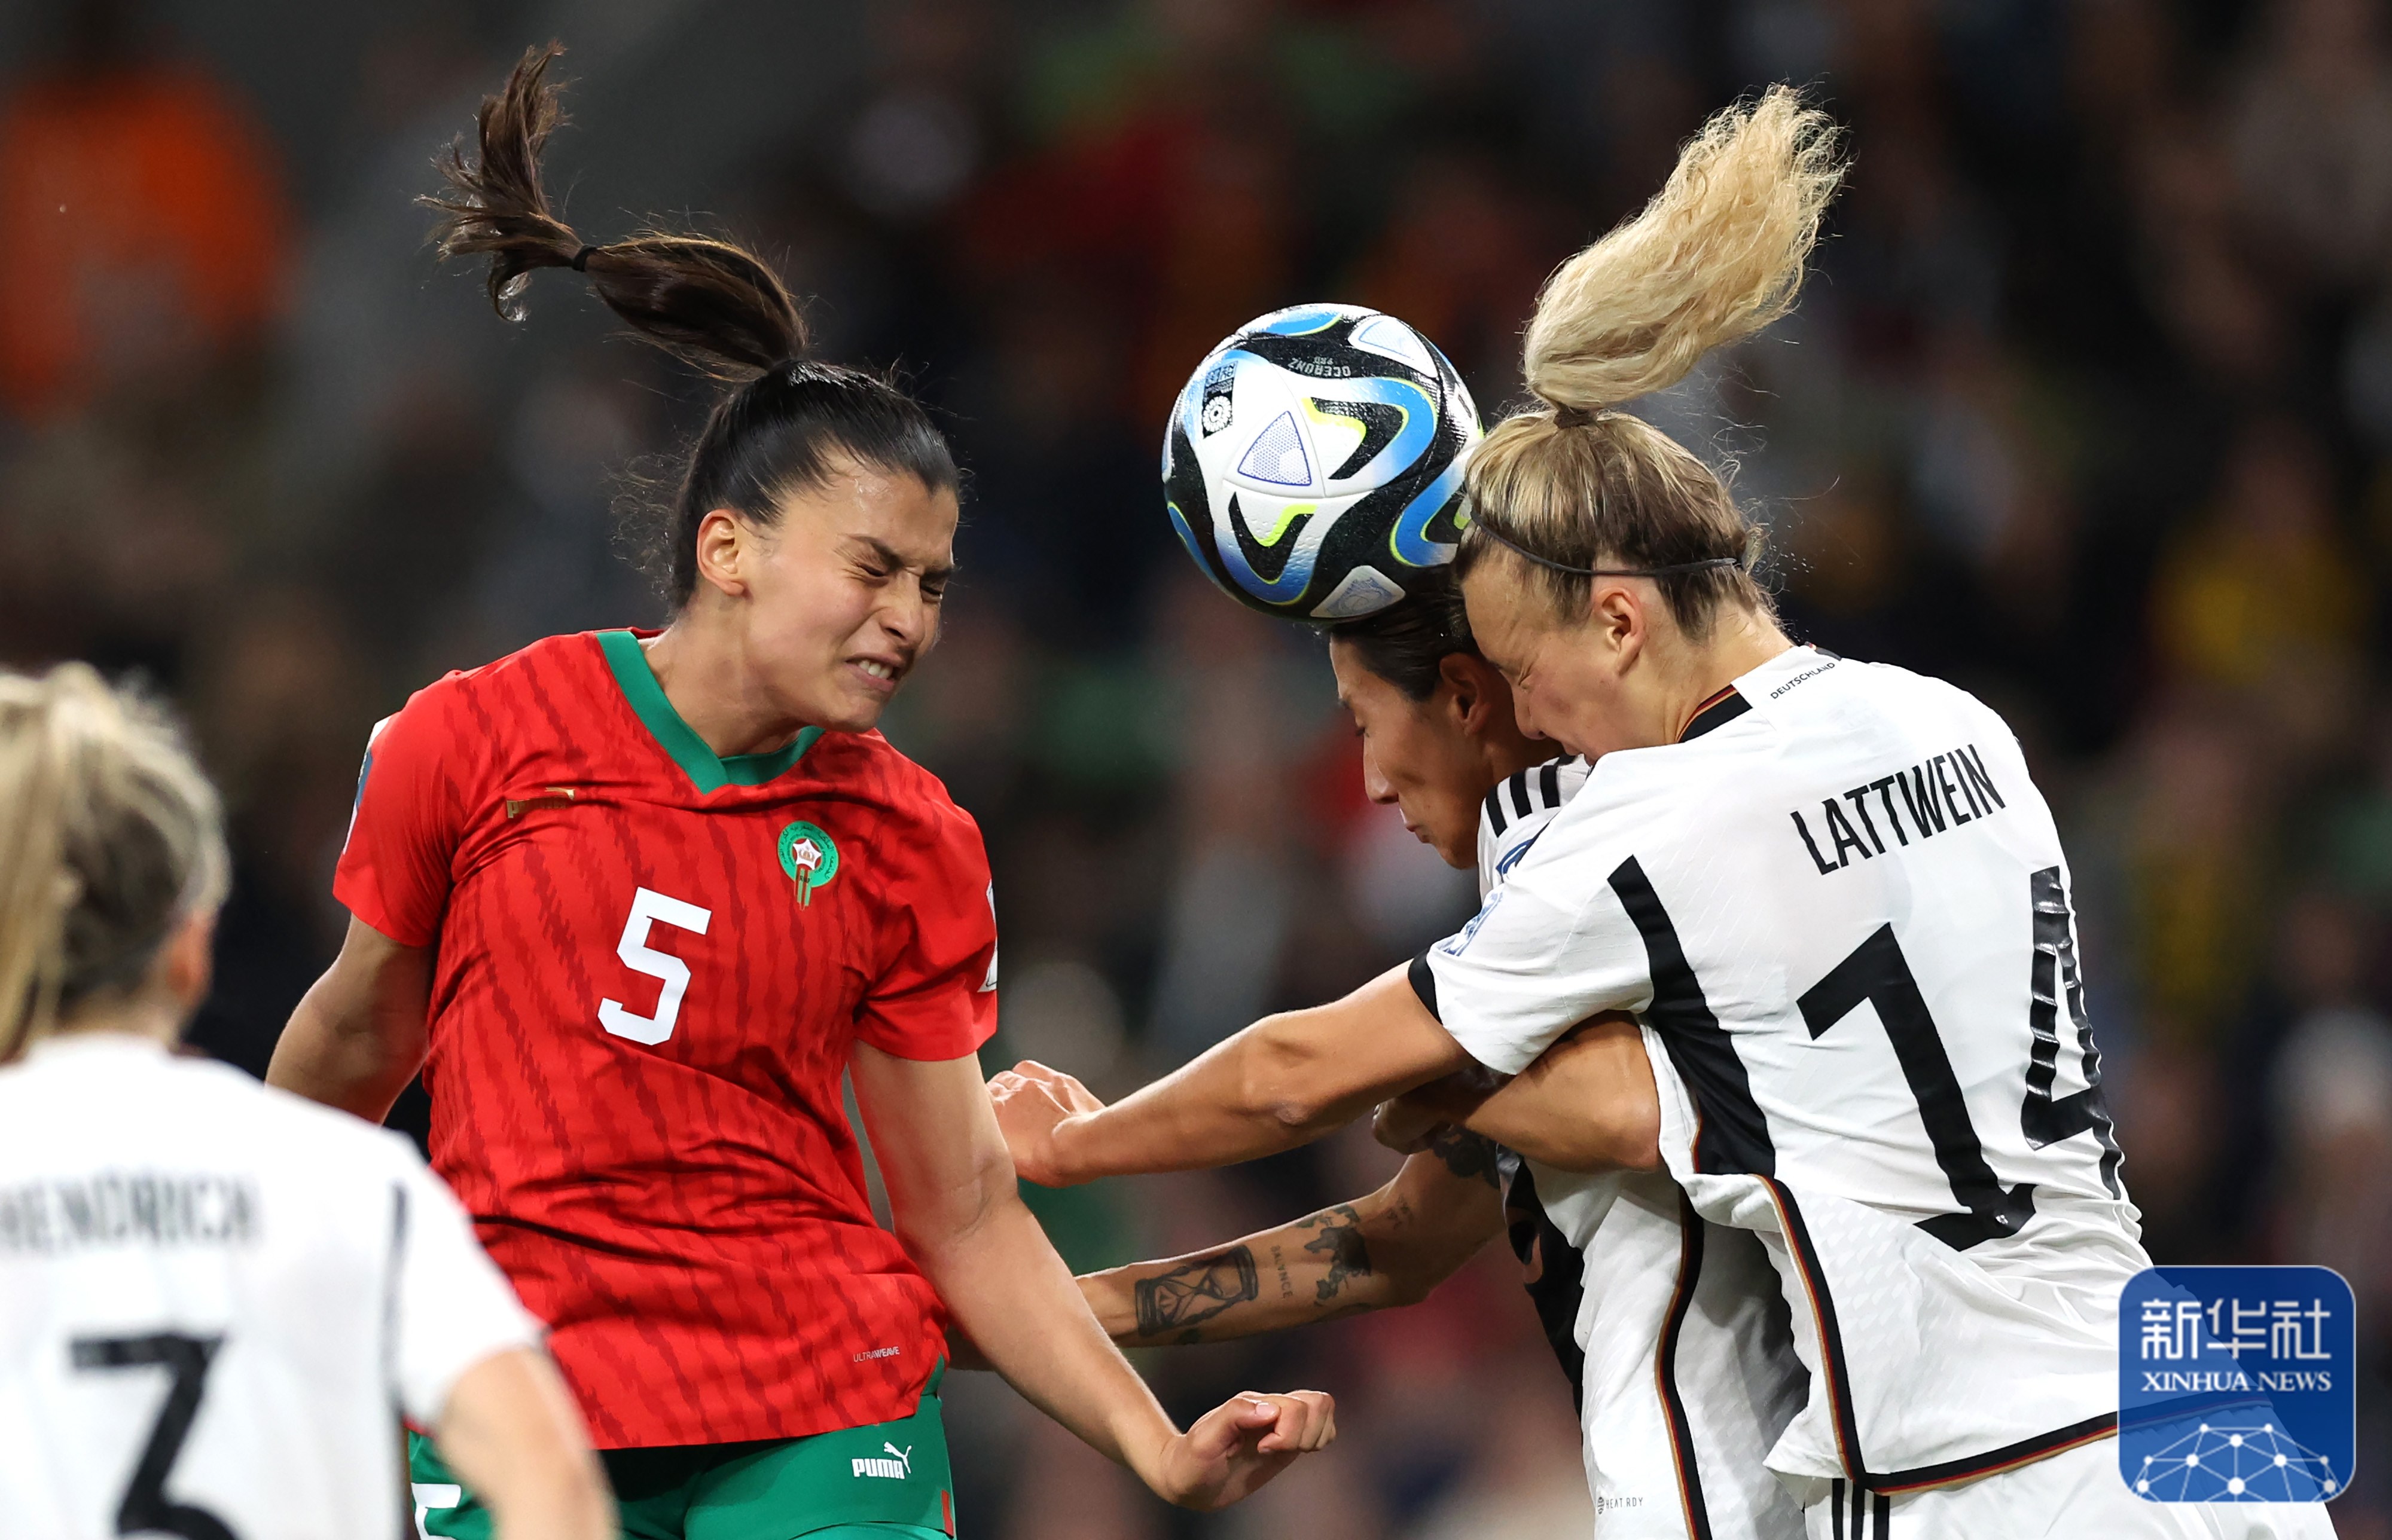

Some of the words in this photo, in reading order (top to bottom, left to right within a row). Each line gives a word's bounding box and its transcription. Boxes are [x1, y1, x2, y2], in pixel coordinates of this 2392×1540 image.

[1770, 662, 1835, 699] DEUTSCHLAND
[1790, 744, 2006, 876] LATTWEIN
[598, 887, 712, 1046] 5
[1796, 865, 2125, 1252] 14
[853, 1346, 900, 1362] ULTRAWEAVE
[71, 1330, 242, 1540] 3
[852, 1458, 905, 1480] PUMA
